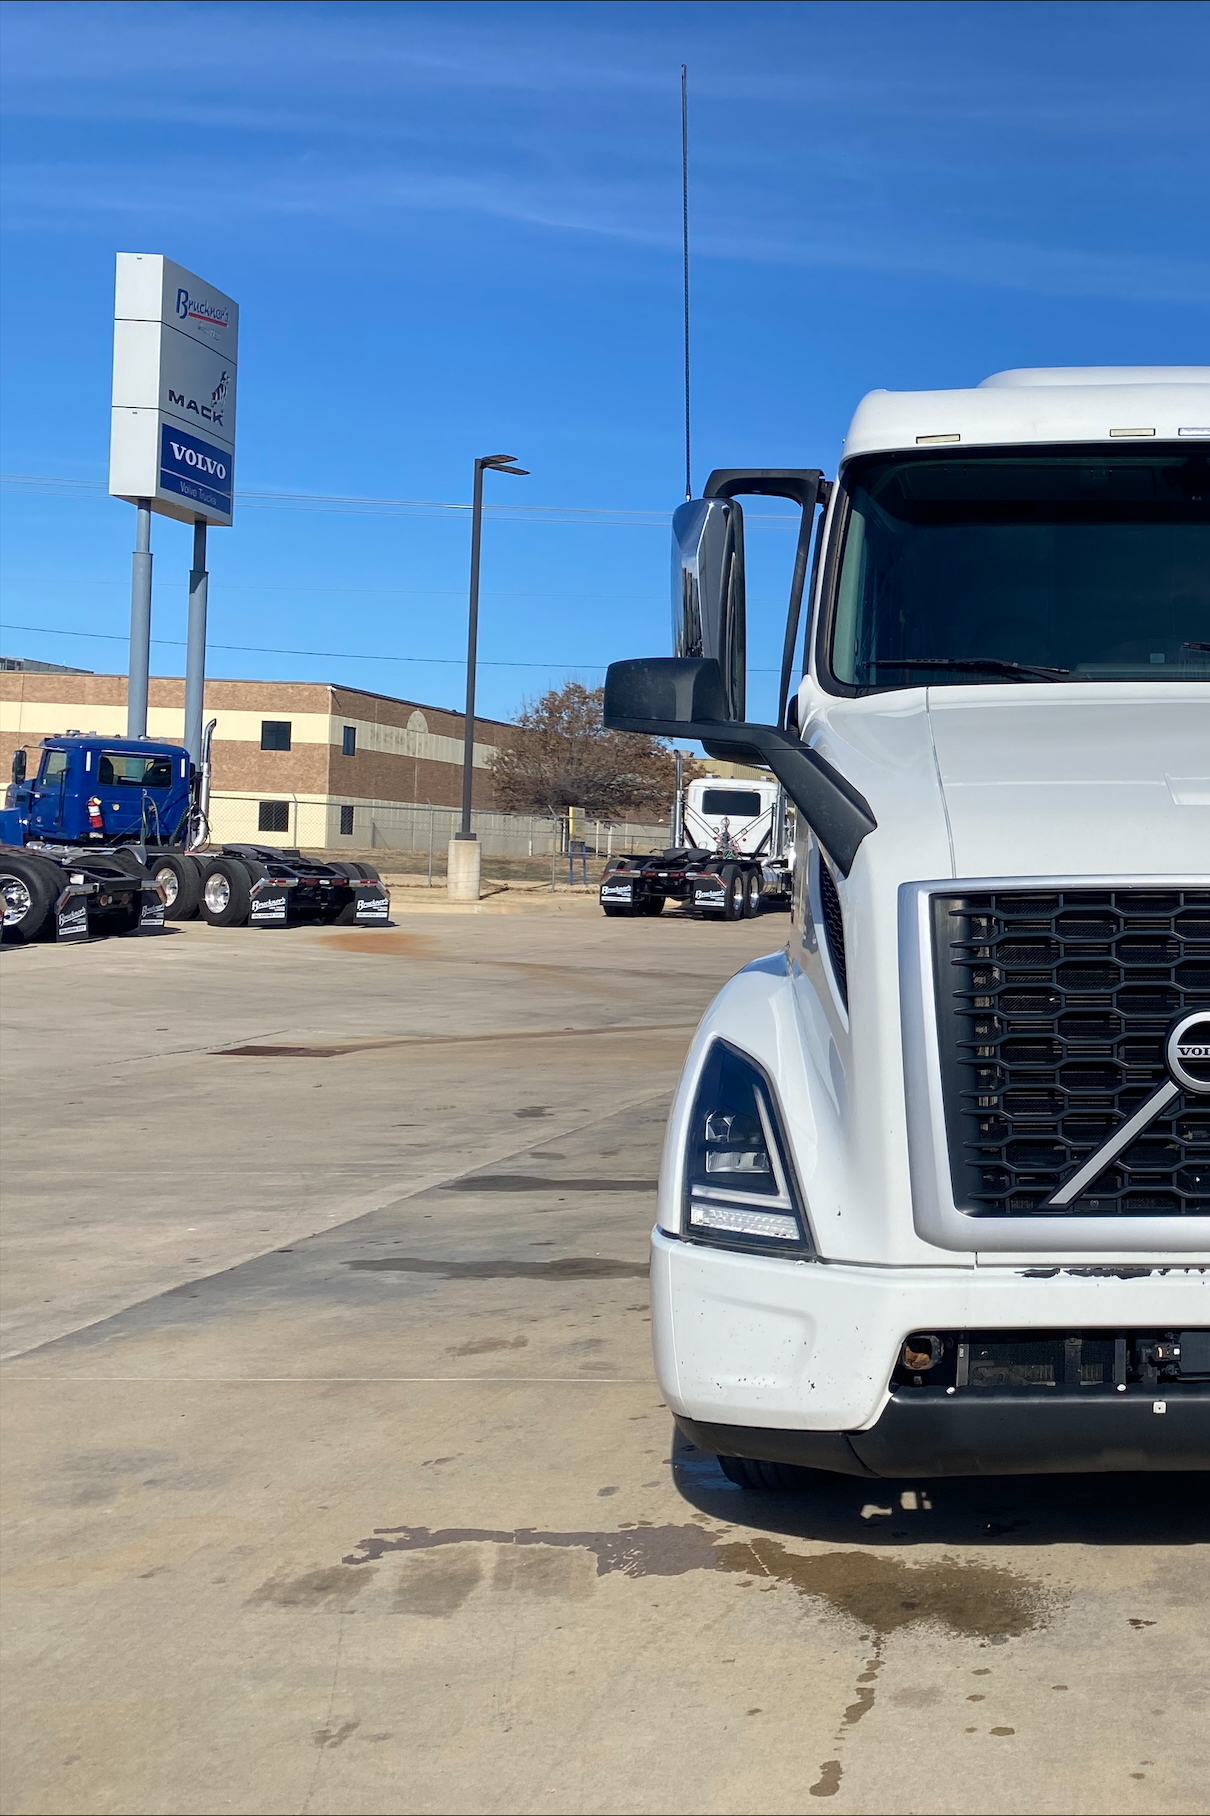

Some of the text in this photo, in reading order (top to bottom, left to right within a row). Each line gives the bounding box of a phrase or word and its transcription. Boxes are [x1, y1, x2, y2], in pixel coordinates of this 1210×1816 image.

[175, 288, 229, 322] Bruckner's
[168, 389, 224, 427] MACK
[169, 441, 227, 480] VOLVO
[179, 480, 198, 497] Volvo
